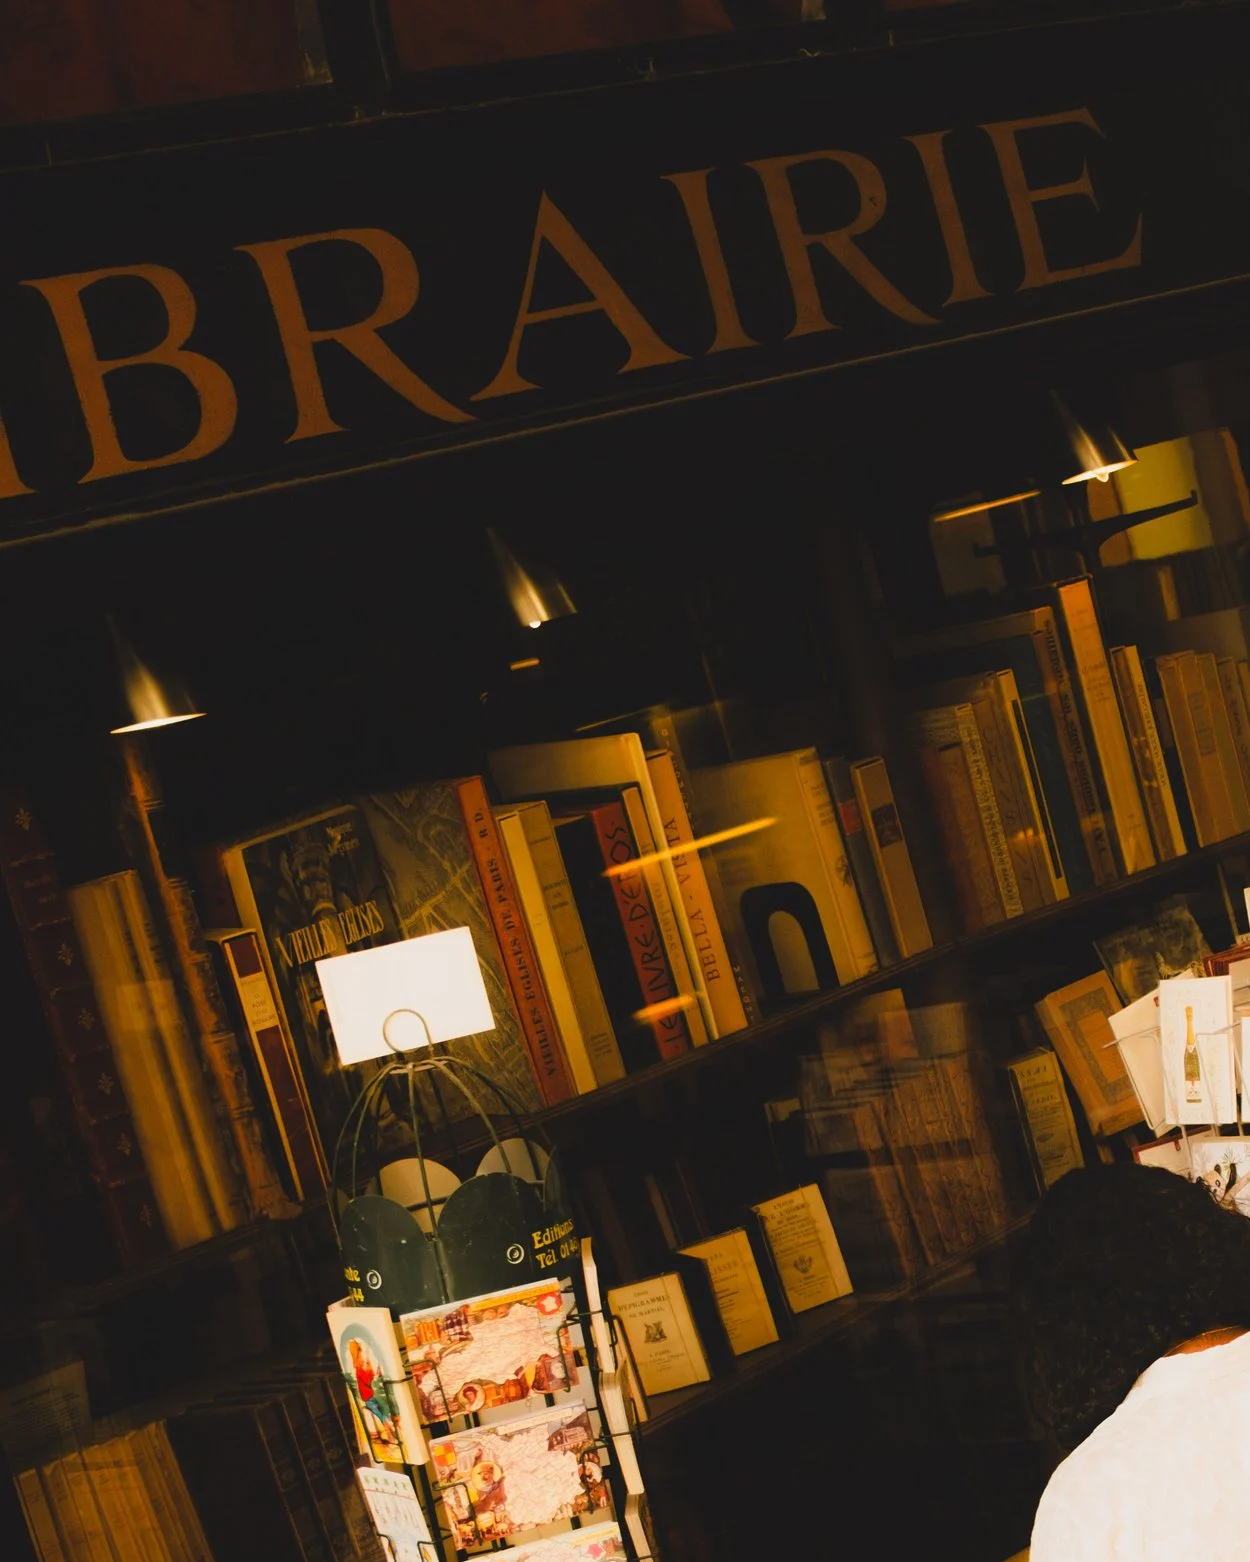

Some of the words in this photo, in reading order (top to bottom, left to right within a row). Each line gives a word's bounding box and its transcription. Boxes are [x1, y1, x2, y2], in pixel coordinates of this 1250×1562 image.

[0, 107, 1143, 498] BRAIRIE
[485, 856, 508, 904] PARIS
[500, 910, 515, 930] DE
[687, 907, 721, 983] BELLA
[528, 1006, 557, 1077] VIEILLES
